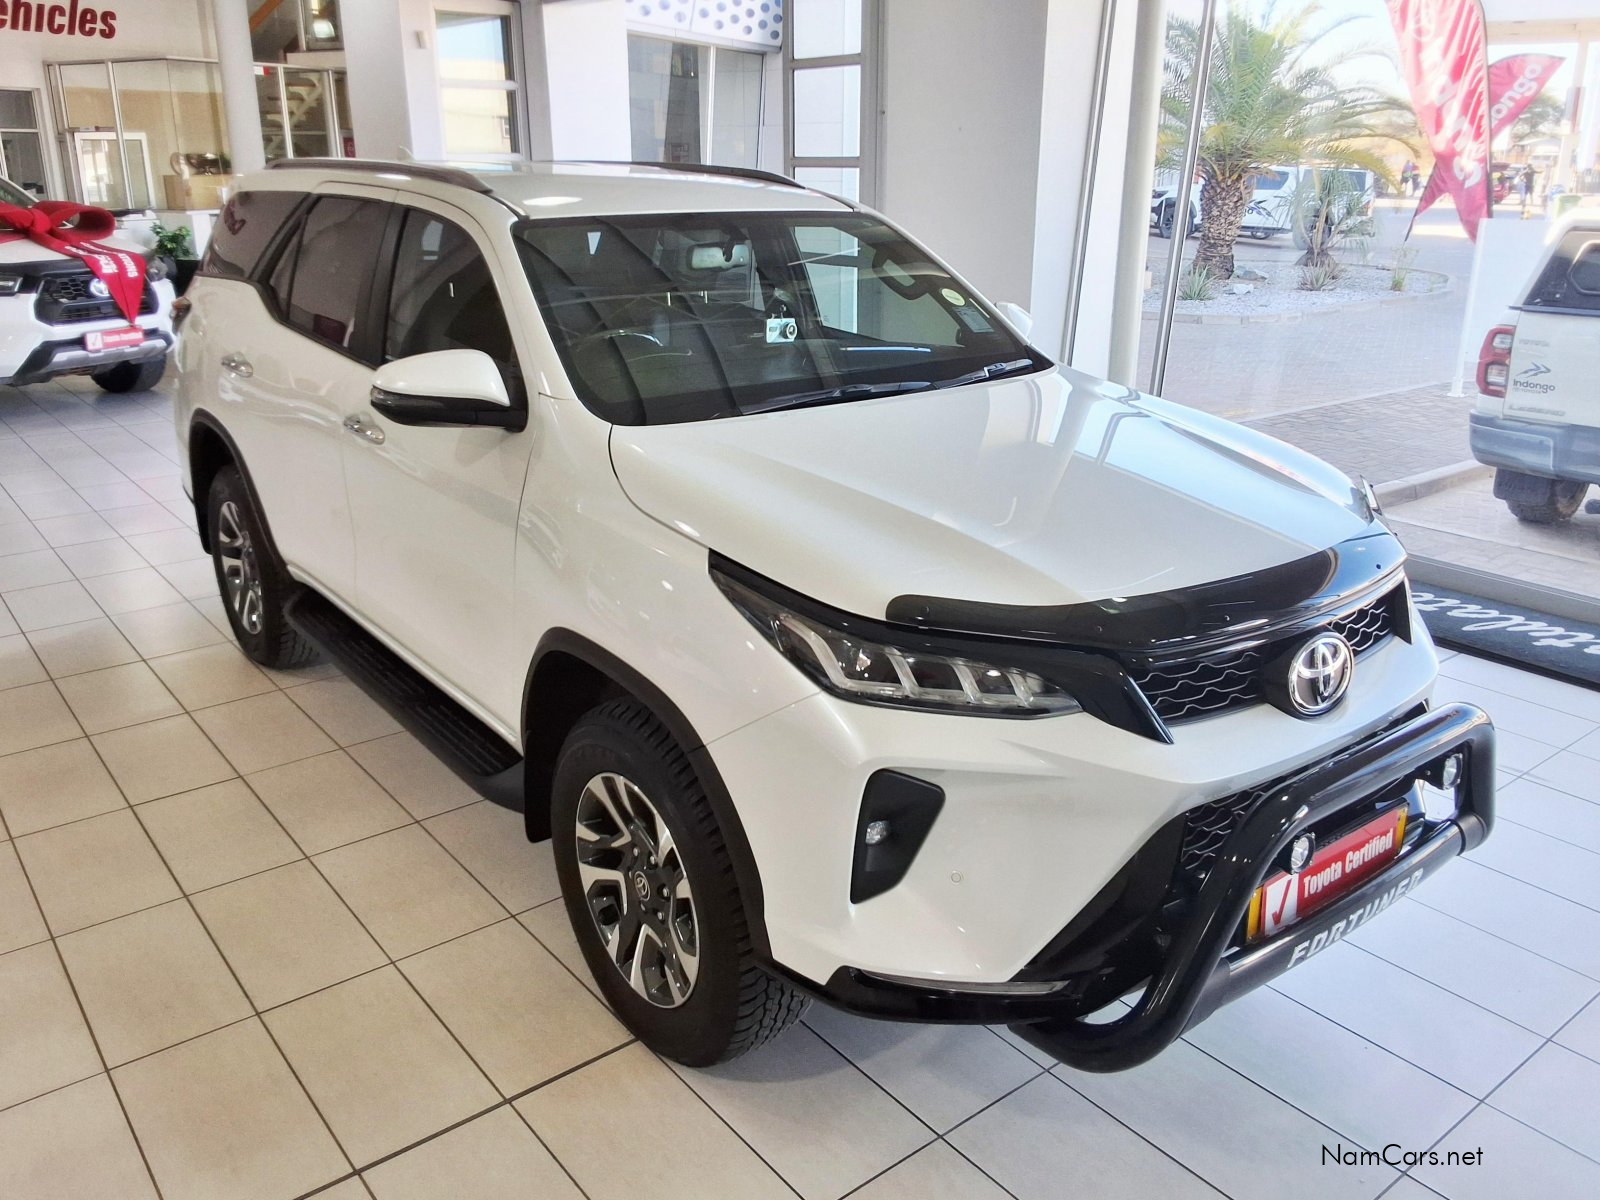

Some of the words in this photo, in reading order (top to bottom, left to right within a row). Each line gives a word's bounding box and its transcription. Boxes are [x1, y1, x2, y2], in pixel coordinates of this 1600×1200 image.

[1491, 62, 1543, 128] ongo
[1512, 379, 1556, 394] Indongo
[1304, 861, 1342, 898] Toyota
[1345, 828, 1393, 874] Certified
[1287, 868, 1424, 968] FORTUNER
